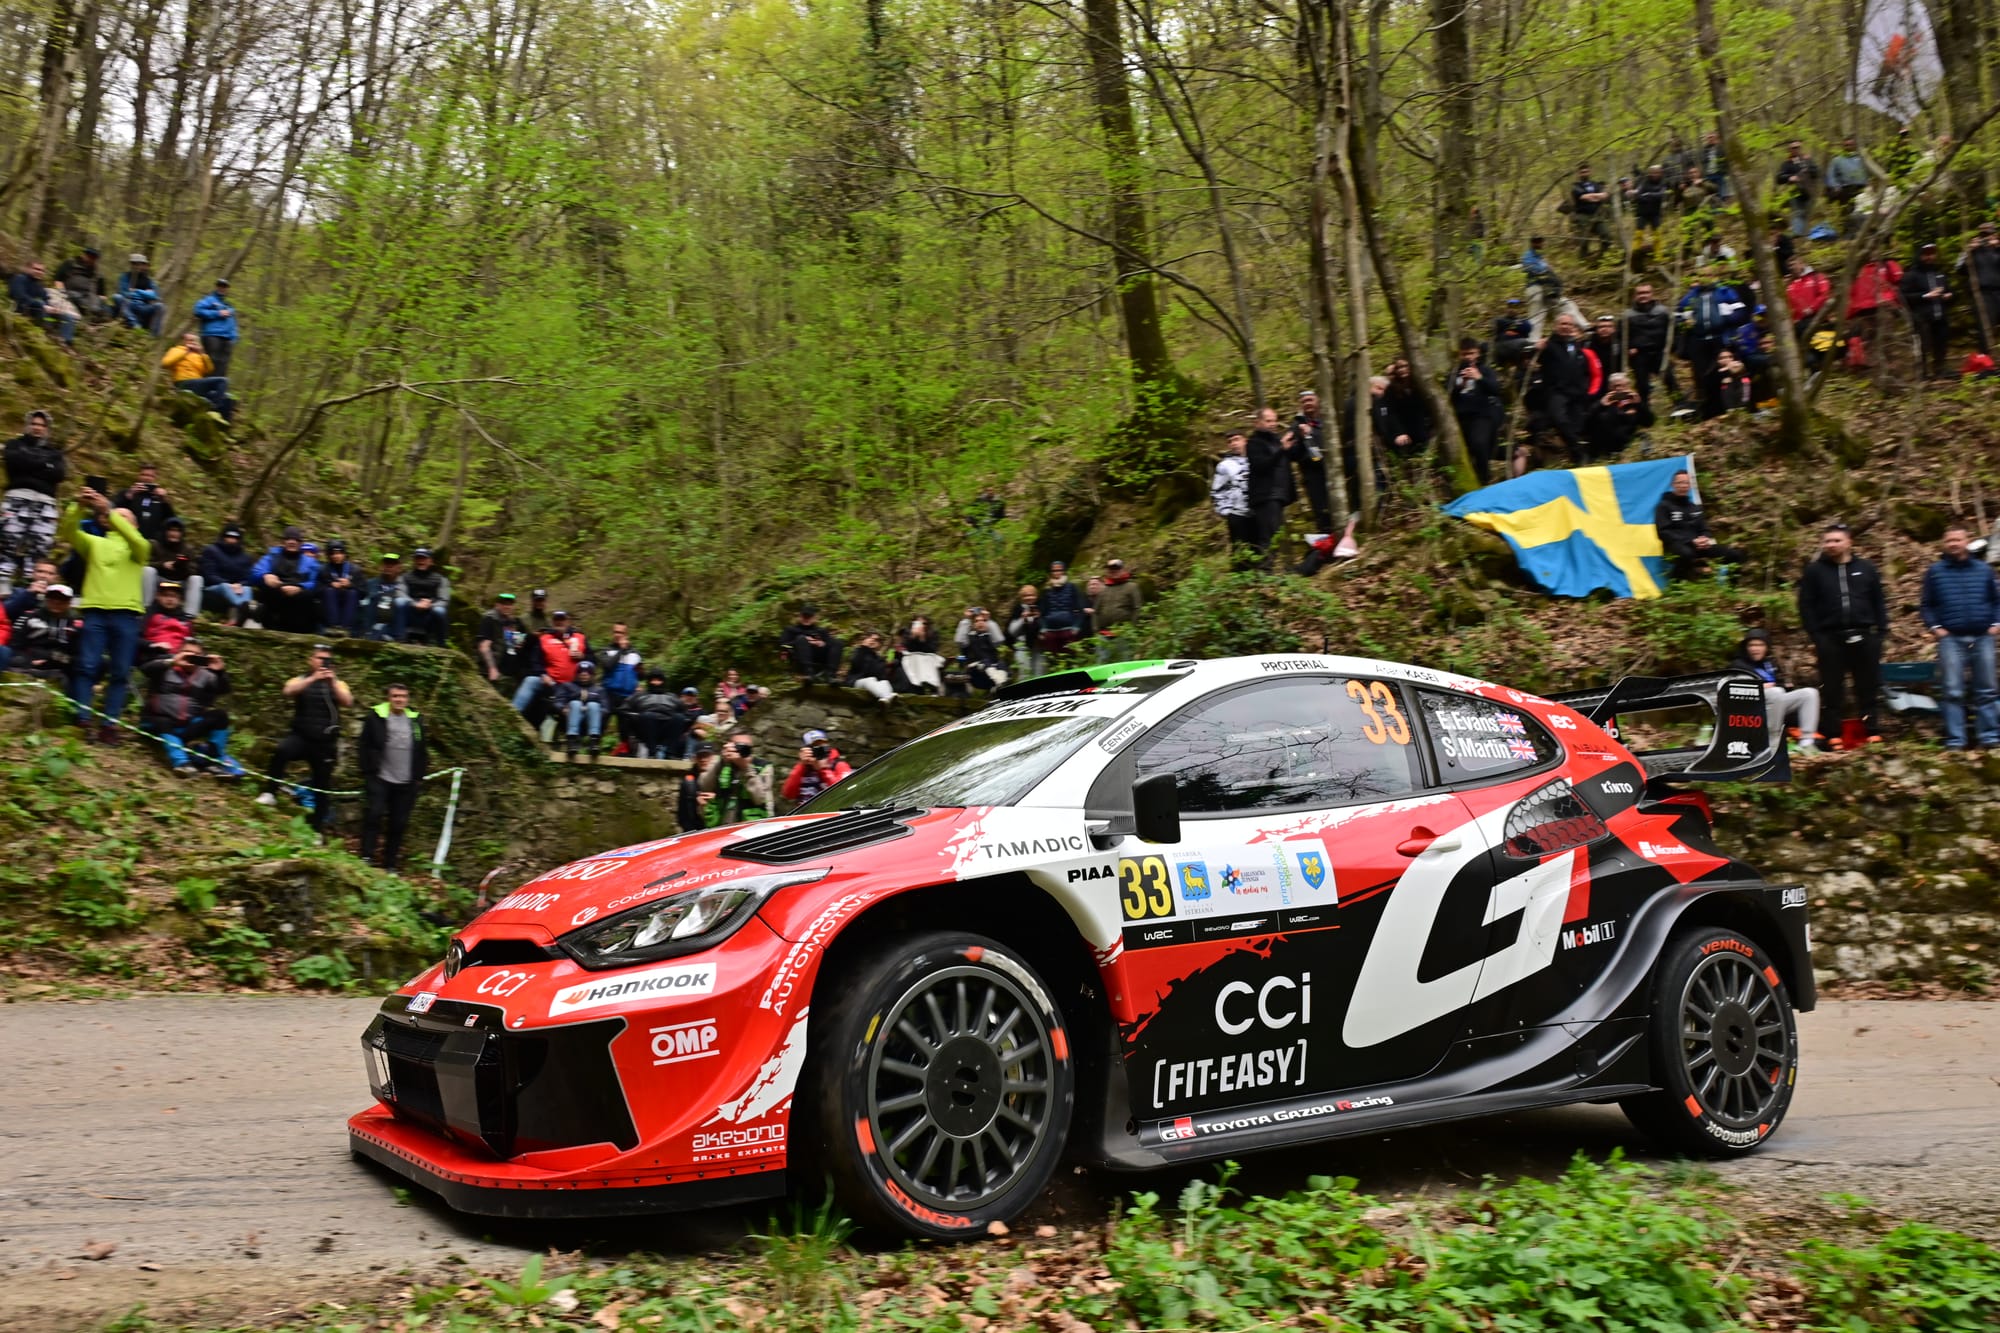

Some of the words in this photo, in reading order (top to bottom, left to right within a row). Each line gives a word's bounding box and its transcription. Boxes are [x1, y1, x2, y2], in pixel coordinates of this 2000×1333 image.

[1260, 659, 1329, 672] PROTERIAL
[1346, 679, 1411, 745] 33
[1435, 710, 1500, 733] E.Evans
[1728, 714, 1763, 729] DENSO
[1101, 719, 1144, 752] CENTRAL
[1441, 736, 1512, 760] S.Martin
[980, 835, 1083, 859] TAMADIC
[1067, 864, 1115, 883] PIAA
[606, 866, 749, 910] codebeamer
[1118, 855, 1172, 919] 33
[1144, 929, 1174, 941] WRC
[1562, 924, 1601, 950] Mobil
[759, 894, 857, 1010] Panasonic
[774, 893, 876, 1017] AUTOMOTIVE
[651, 1025, 718, 1057] OMP
[1336, 1095, 1394, 1112] Racing
[1160, 1124, 1197, 1141] GR
